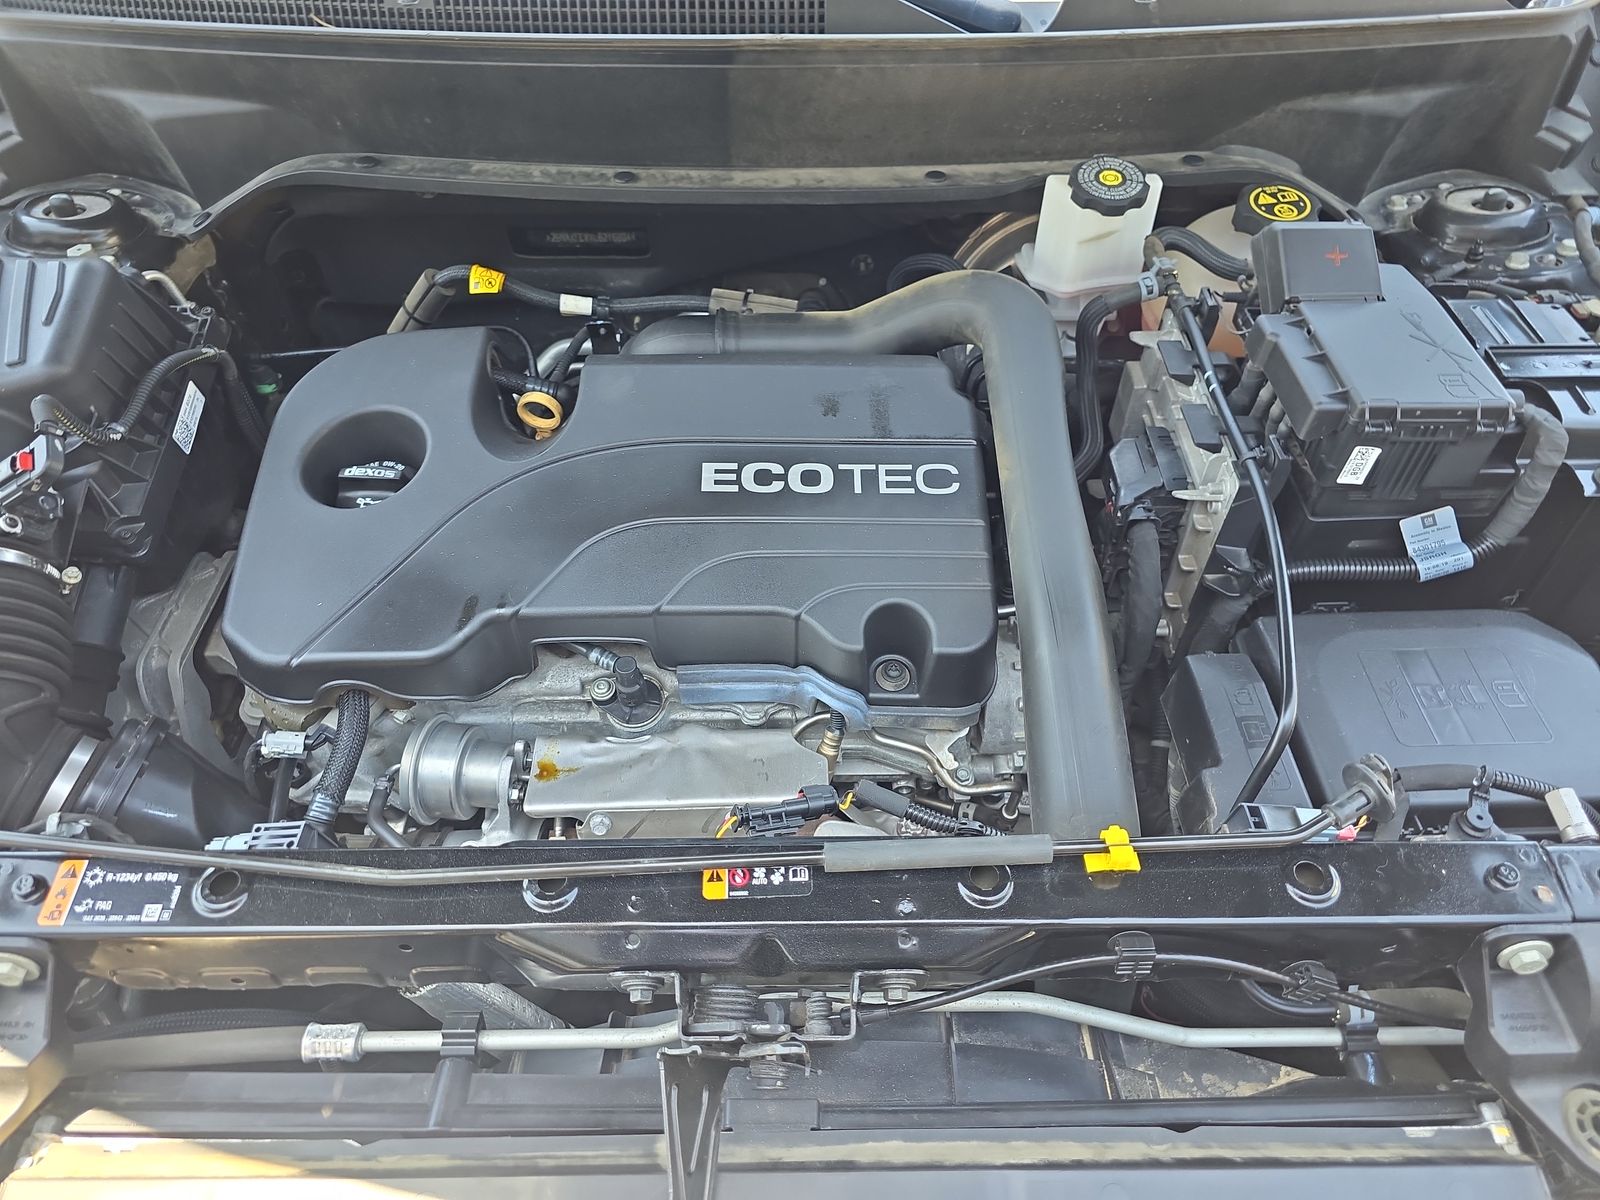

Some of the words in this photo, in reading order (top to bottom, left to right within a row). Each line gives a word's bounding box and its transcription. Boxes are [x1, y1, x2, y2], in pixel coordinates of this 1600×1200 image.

[344, 466, 396, 478] dexos
[700, 462, 960, 495] ECOTEC
[95, 900, 113, 911] PAG
